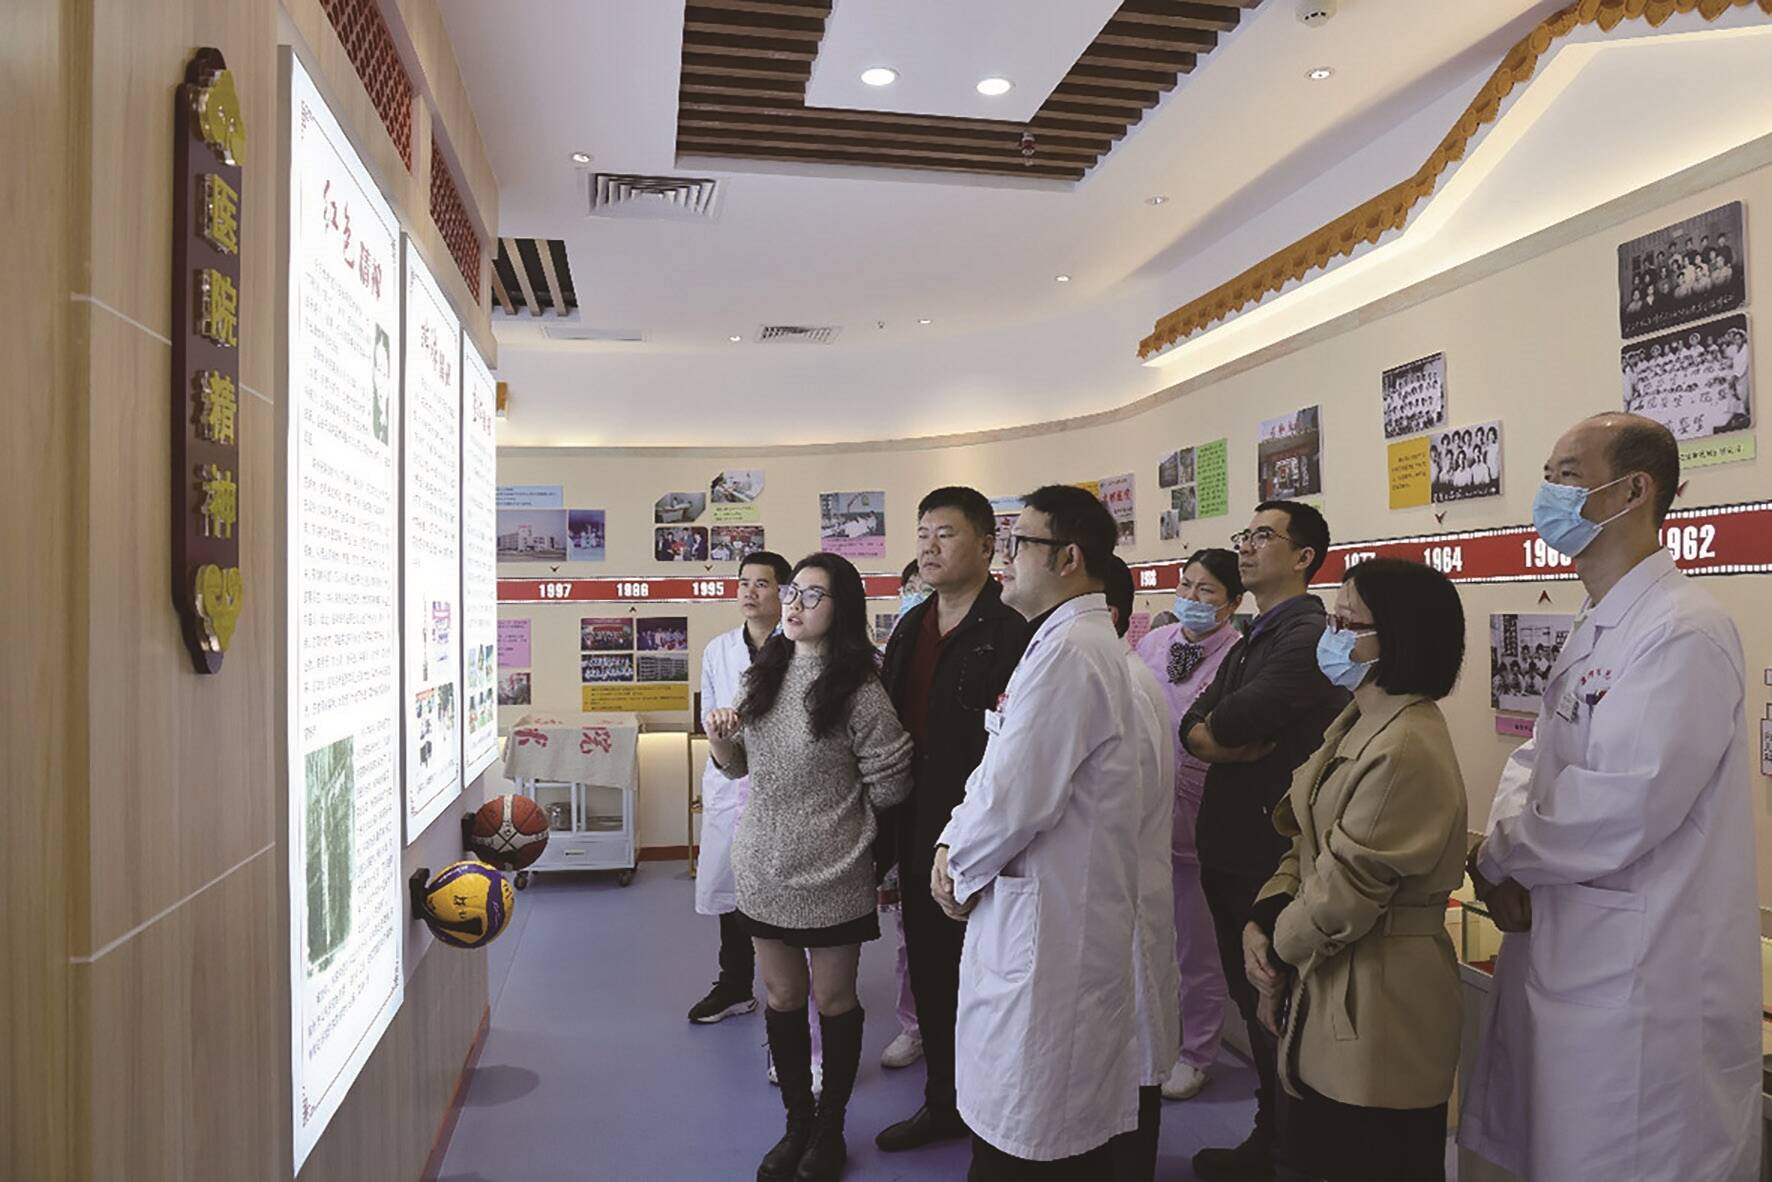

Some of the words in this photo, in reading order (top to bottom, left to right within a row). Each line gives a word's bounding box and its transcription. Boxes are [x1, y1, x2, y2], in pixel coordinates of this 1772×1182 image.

[204, 172, 238, 538] 医院精神
[538, 583, 572, 598] 1997
